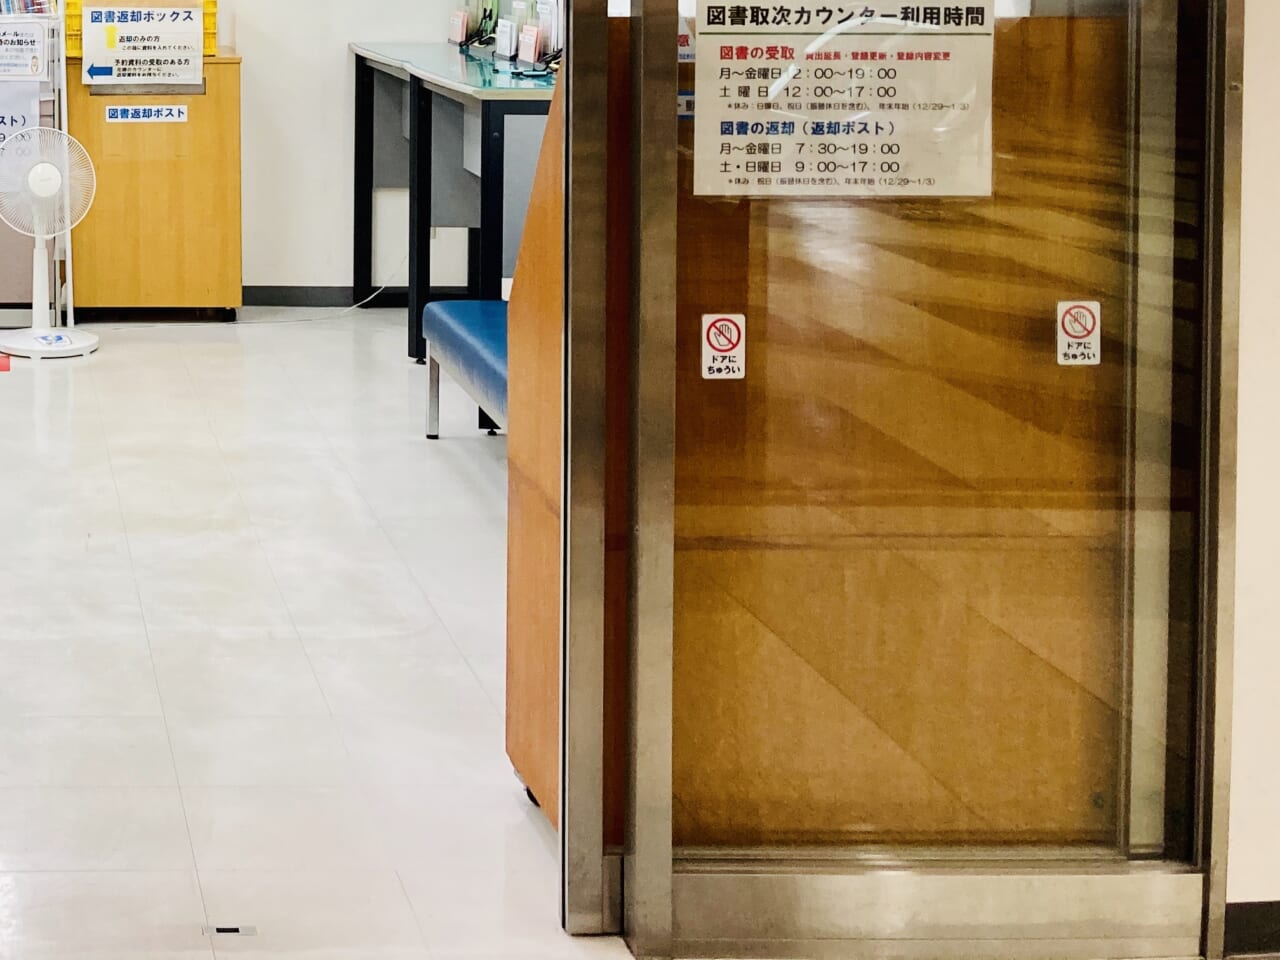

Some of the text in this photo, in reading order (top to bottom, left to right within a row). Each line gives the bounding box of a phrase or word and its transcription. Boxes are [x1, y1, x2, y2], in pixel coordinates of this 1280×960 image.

[91, 10, 194, 23] 図書返却ボックス
[707, 5, 985, 27] 図書取次カウンター利用時間
[720, 45, 795, 60] 図書の受取
[108, 108, 185, 119] 図書返却ポスト
[720, 121, 895, 136] 図書の返却（返却ポスト）
[1066, 341, 1092, 351] ドアに
[710, 354, 737, 364] ドアに
[1062, 351, 1096, 361] ちゅうい
[706, 364, 741, 375] ちゅうい
